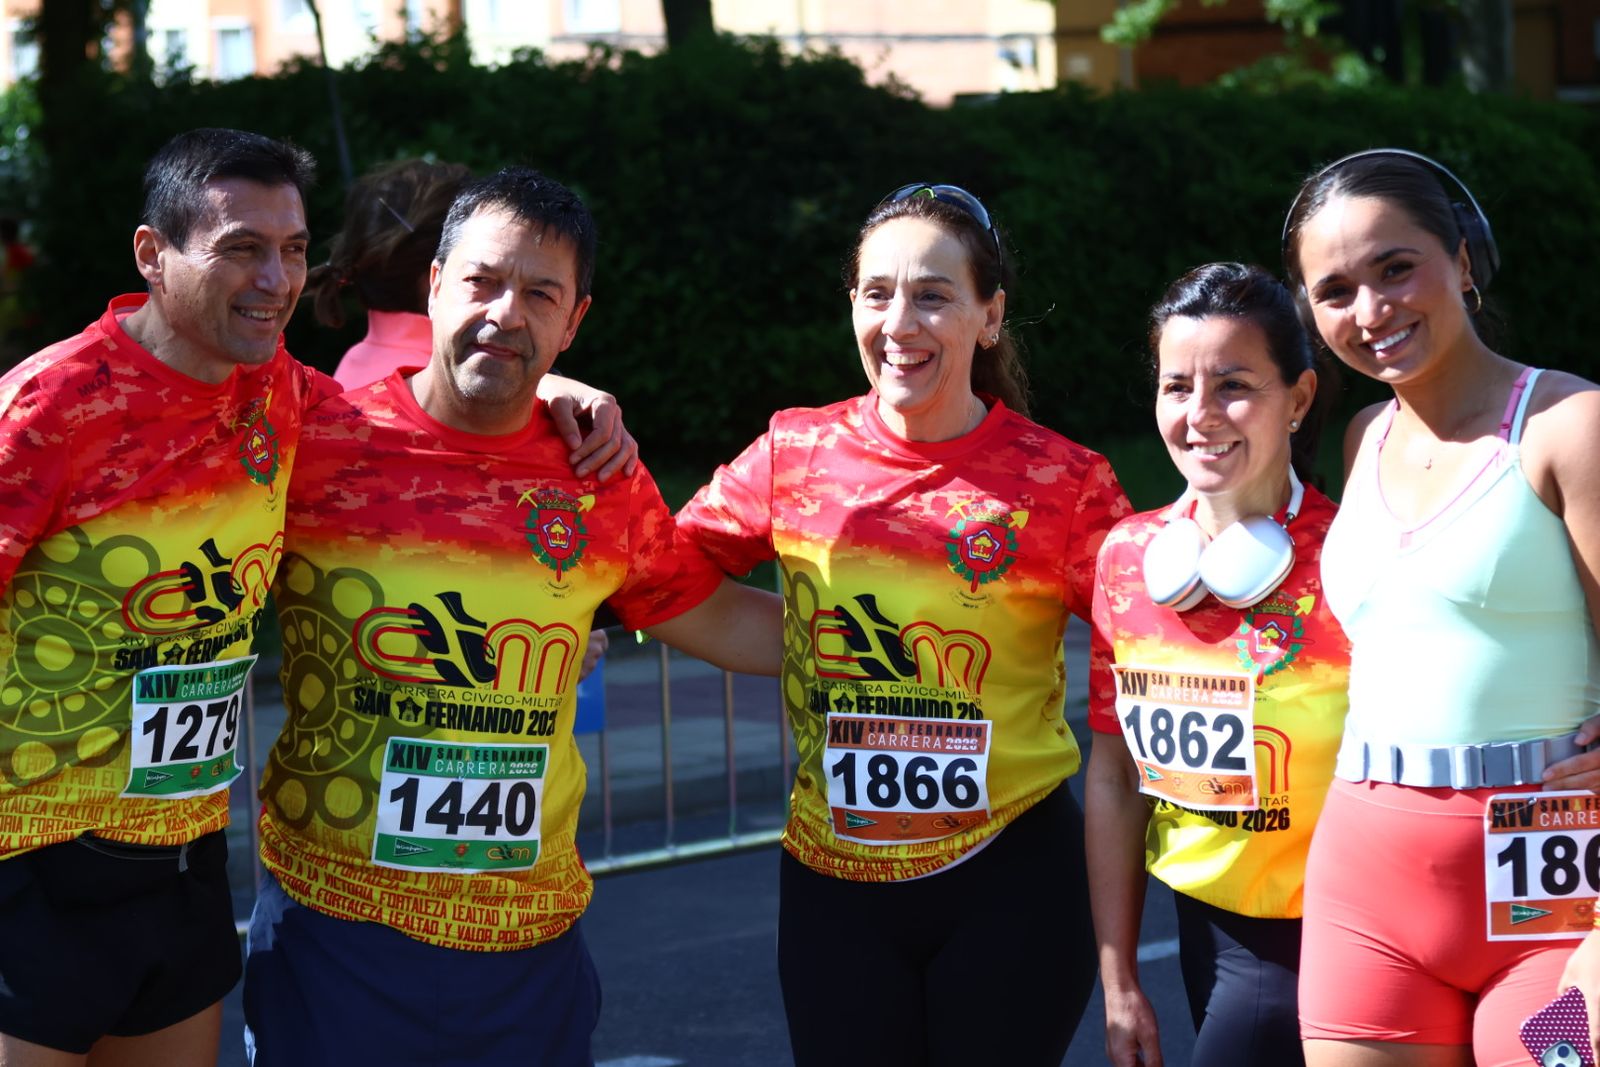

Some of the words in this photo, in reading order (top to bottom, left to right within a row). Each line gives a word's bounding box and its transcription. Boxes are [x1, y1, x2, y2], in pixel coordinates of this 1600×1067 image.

[119, 637, 146, 647] XIV
[114, 647, 158, 670] SAN
[140, 673, 180, 699] XIV
[181, 679, 231, 698] CARRERA
[184, 672, 204, 684] SAN
[355, 676, 377, 686] XIV
[384, 681, 456, 700] CARRERA
[821, 680, 884, 695] CARRERA
[1119, 671, 1148, 697] XIV
[1152, 673, 1170, 686] SAN
[1180, 676, 1246, 692] FERNANDO
[354, 687, 391, 718] SAN
[425, 701, 525, 735] FERNANDO
[856, 696, 953, 719] FERNANDO
[143, 695, 239, 763] 1279
[830, 720, 864, 744] XIV
[869, 721, 895, 734] SAN
[909, 723, 982, 738] FERNANDO
[1124, 705, 1246, 771] 1862
[868, 733, 941, 749] CARRERA
[391, 743, 432, 771] XIV
[437, 747, 462, 760] SAN
[474, 750, 543, 762] FERNANDO
[435, 759, 506, 775] CARRERA
[832, 752, 980, 810] 1866
[53, 801, 104, 823] LEALTAD
[390, 777, 536, 837] 1440
[1491, 801, 1534, 829] XIV
[1540, 799, 1570, 812] SAN
[1242, 807, 1290, 832] 2026
[906, 839, 955, 856] TRABAJO
[427, 871, 464, 893] VALOR
[468, 879, 492, 894] POR
[496, 880, 508, 895] EL
[325, 872, 373, 901] VICTORIA
[379, 891, 447, 919] FORTALEZA
[452, 903, 500, 927] LEALTAD
[505, 910, 512, 928] Y
[510, 894, 535, 909] POR
[538, 893, 548, 911] EL
[316, 887, 383, 922] FORTALEZA
[388, 910, 439, 935] LEALTAD
[445, 922, 452, 938] Y
[458, 925, 493, 944] VALOR
[496, 930, 520, 944] POR
[523, 928, 534, 942] EL
